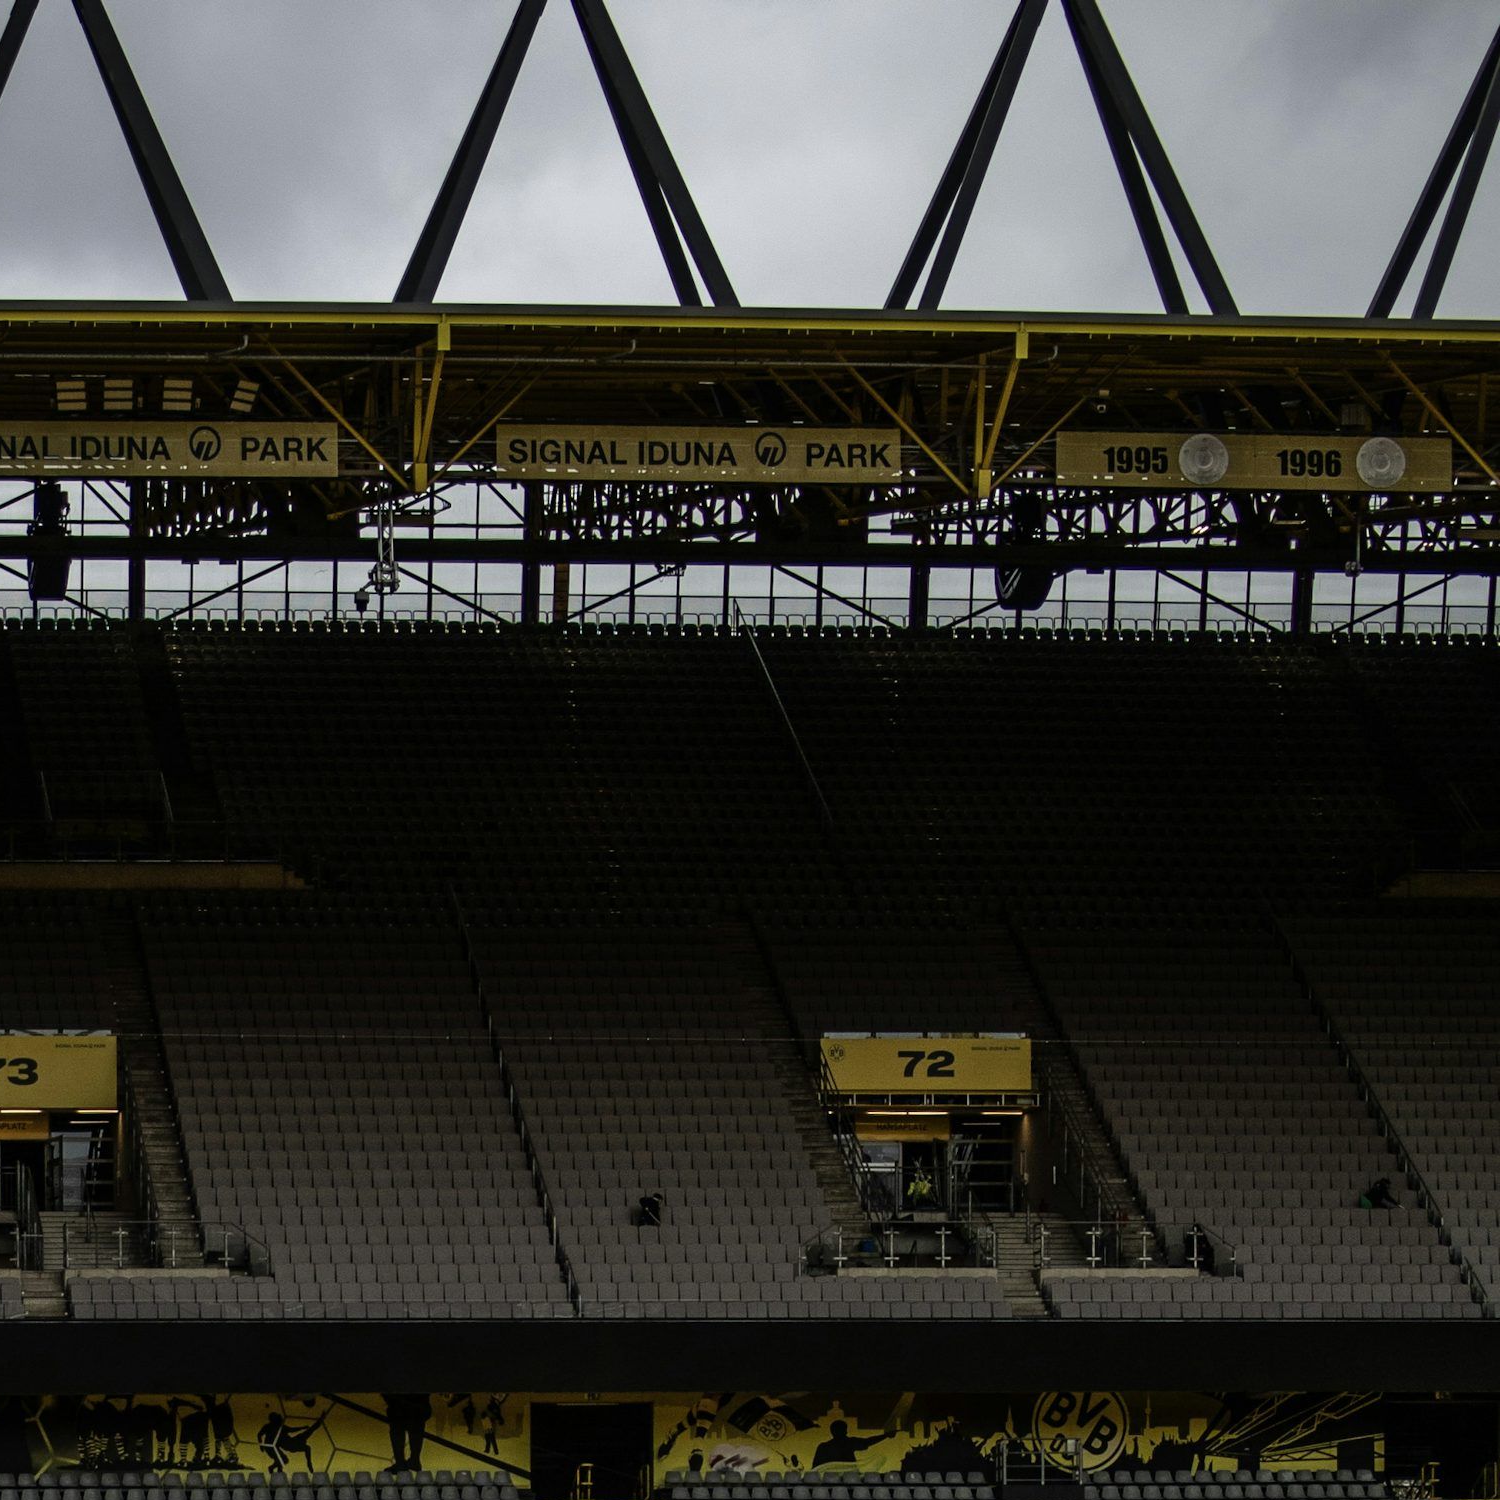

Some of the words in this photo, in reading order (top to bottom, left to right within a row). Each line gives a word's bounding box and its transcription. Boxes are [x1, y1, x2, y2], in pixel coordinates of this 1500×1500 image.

[71, 436, 172, 461] IDUNA
[241, 437, 328, 461] PARK
[508, 438, 627, 465] SIGNAL
[638, 440, 738, 467] IDUNA
[805, 443, 892, 468] PARK
[1103, 446, 1169, 474] 1995
[1276, 450, 1342, 477] 1996
[898, 1050, 955, 1077] 72
[1042, 1392, 1118, 1455] BVB
